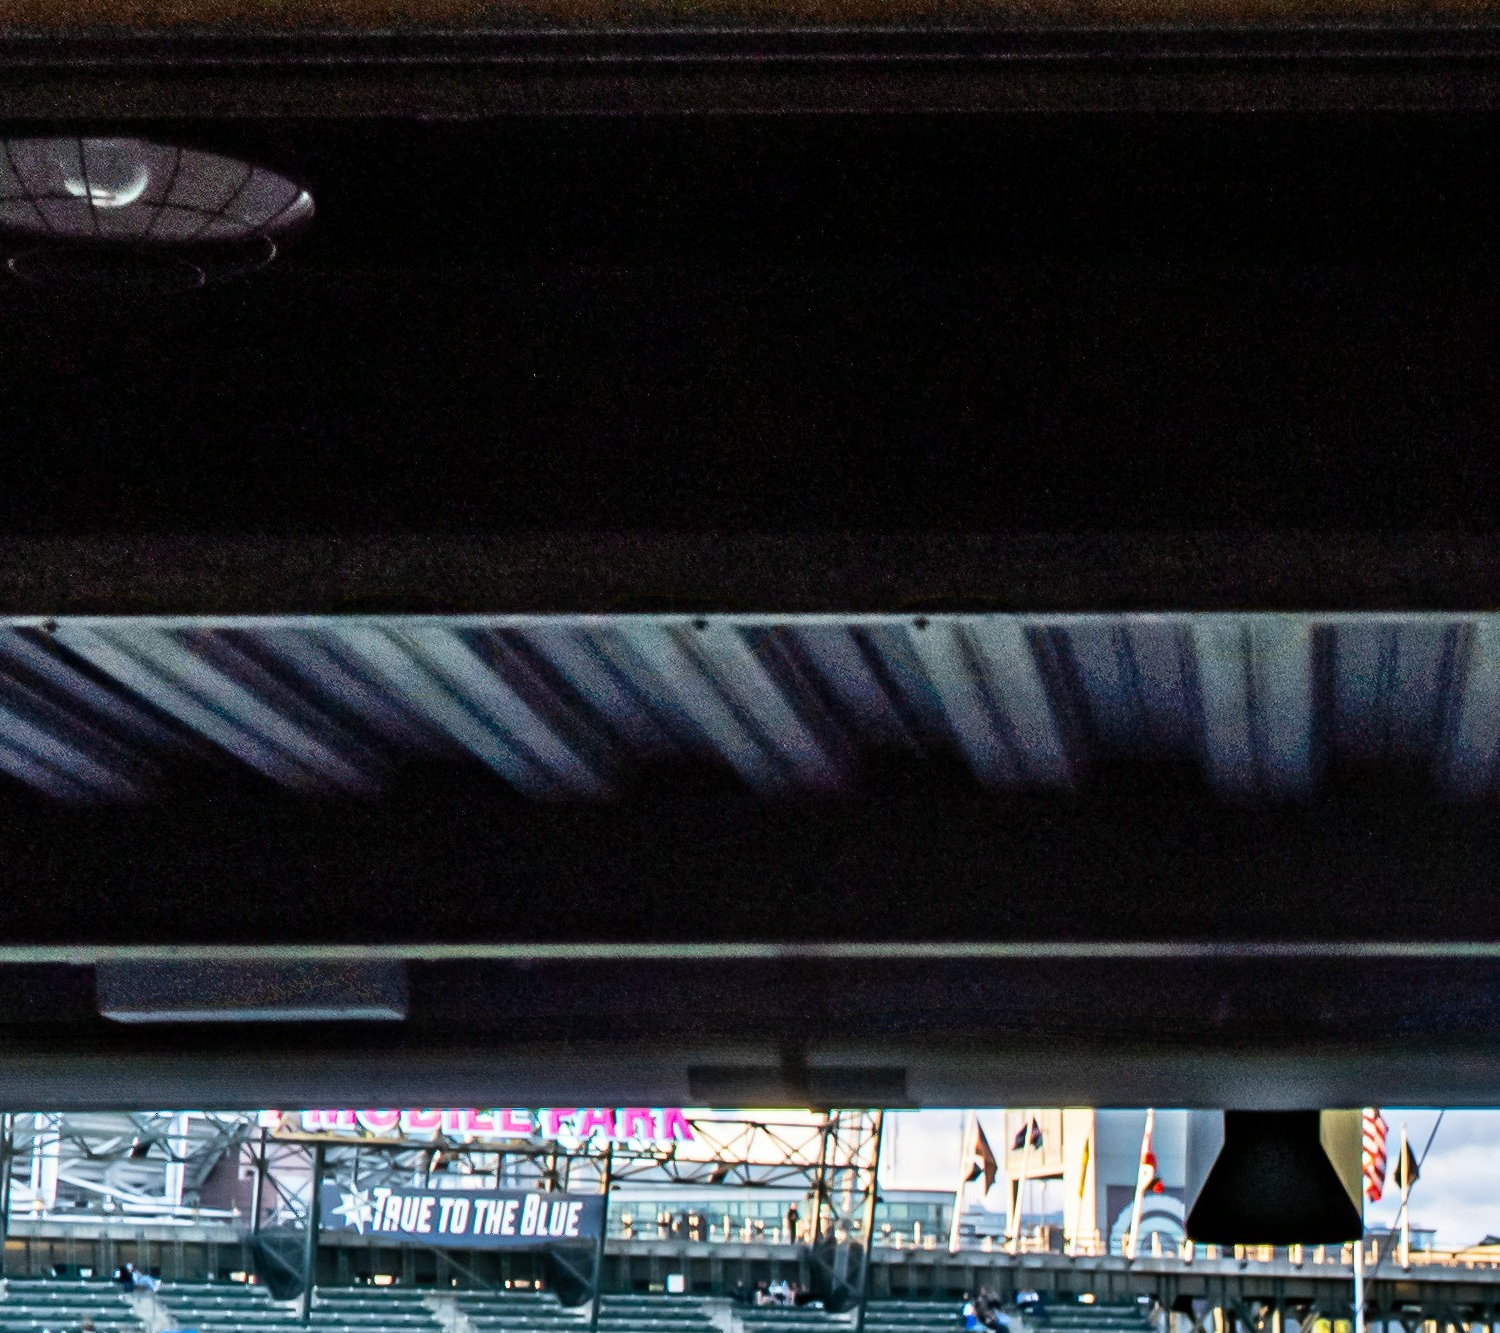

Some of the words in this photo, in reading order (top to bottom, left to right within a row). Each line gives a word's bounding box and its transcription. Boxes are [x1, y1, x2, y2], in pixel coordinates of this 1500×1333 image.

[372, 1187, 431, 1234] TRUE
[439, 1197, 470, 1234] TO
[473, 1199, 516, 1235] THE
[520, 1193, 583, 1237] BLUE
